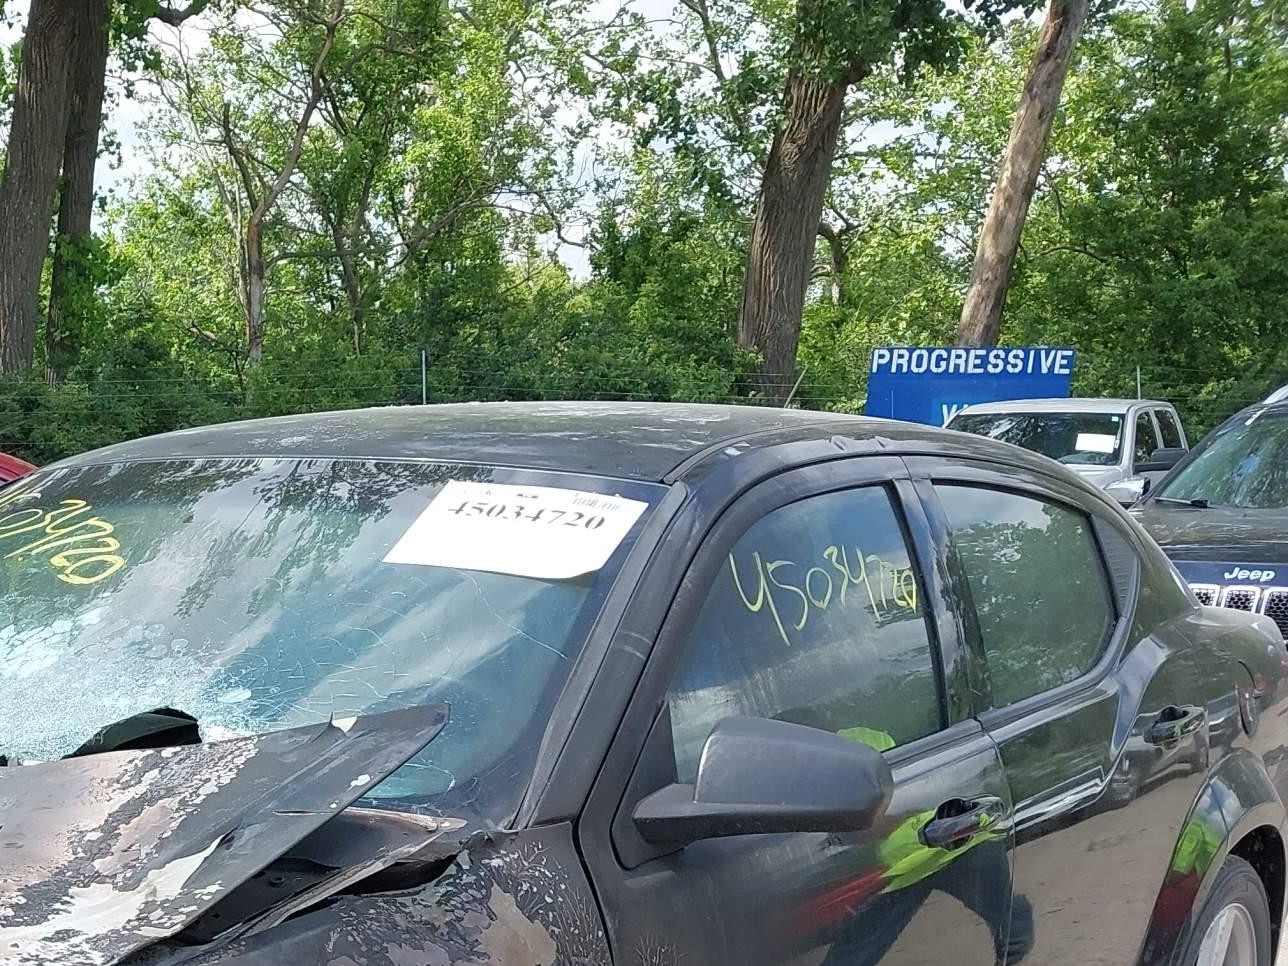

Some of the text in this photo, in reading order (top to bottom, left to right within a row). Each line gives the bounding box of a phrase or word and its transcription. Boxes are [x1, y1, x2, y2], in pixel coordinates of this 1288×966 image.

[871, 349, 1074, 375] PROGRESSIVE
[447, 500, 607, 531] 45034720
[1223, 566, 1276, 583] Jeep
